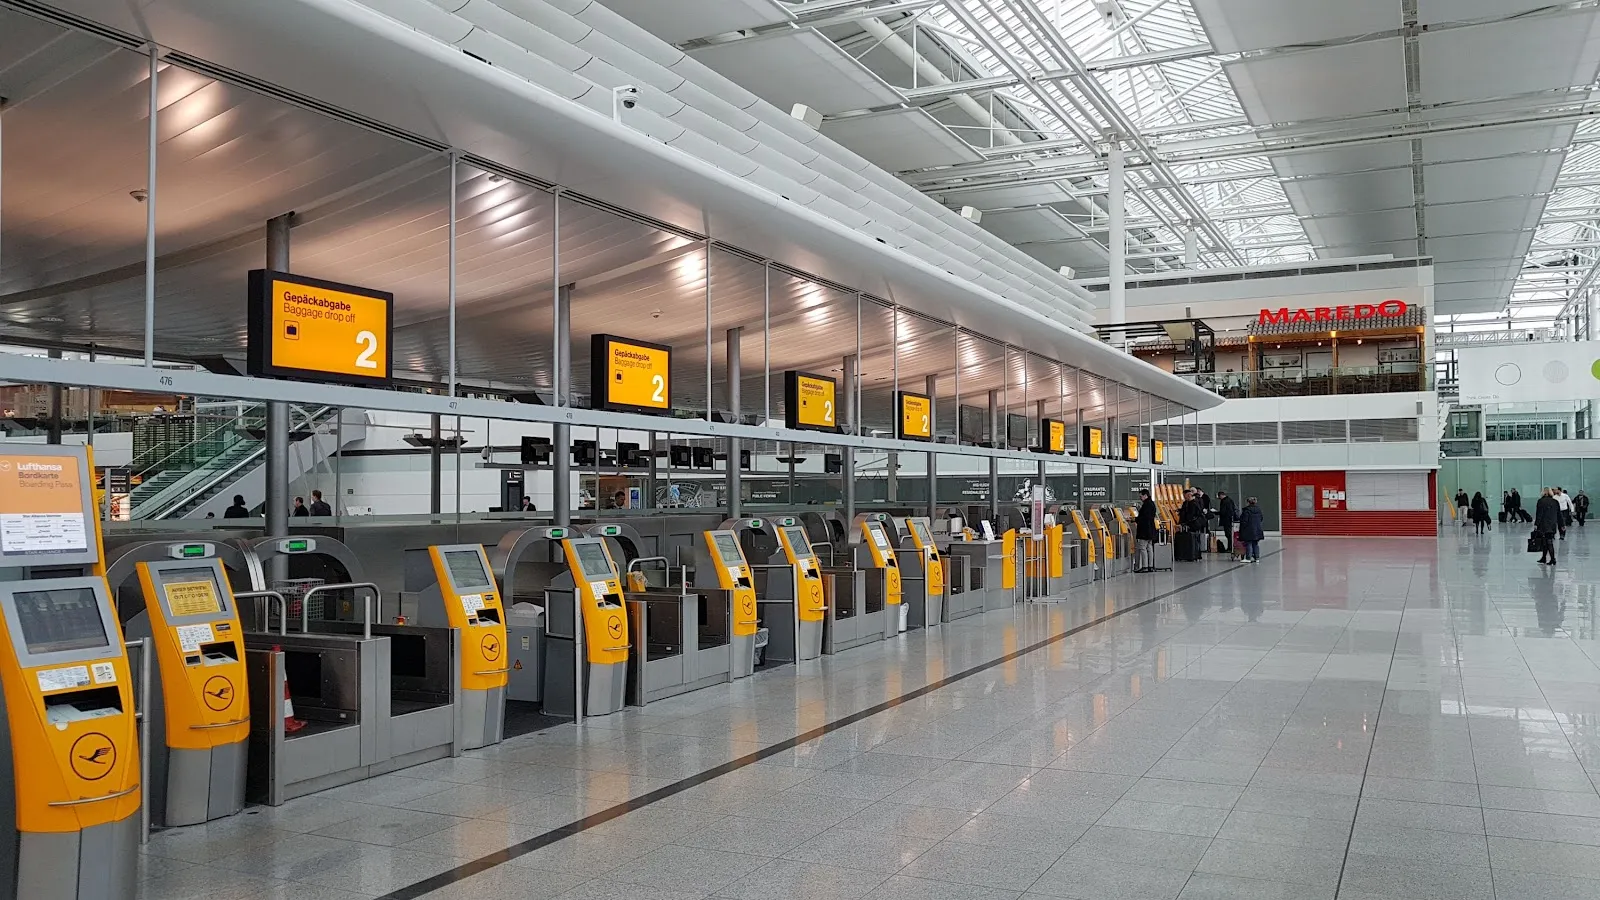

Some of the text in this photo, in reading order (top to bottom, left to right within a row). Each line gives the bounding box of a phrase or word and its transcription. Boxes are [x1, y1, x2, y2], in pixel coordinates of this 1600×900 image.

[284, 291, 351, 311] Gepäckabgabe
[283, 303, 356, 323] Baggage drop off
[355, 330, 378, 369] 2
[614, 348, 650, 361] Gepäckabgabe
[614, 357, 635, 369] Baggage
[635, 361, 647, 370] drop
[159, 376, 173, 386] 476
[651, 374, 665, 403] 2
[824, 400, 833, 422] 2
[922, 414, 929, 433] 2
[17, 462, 63, 472] Lufthansa
[18, 471, 60, 480] Bordkarte
